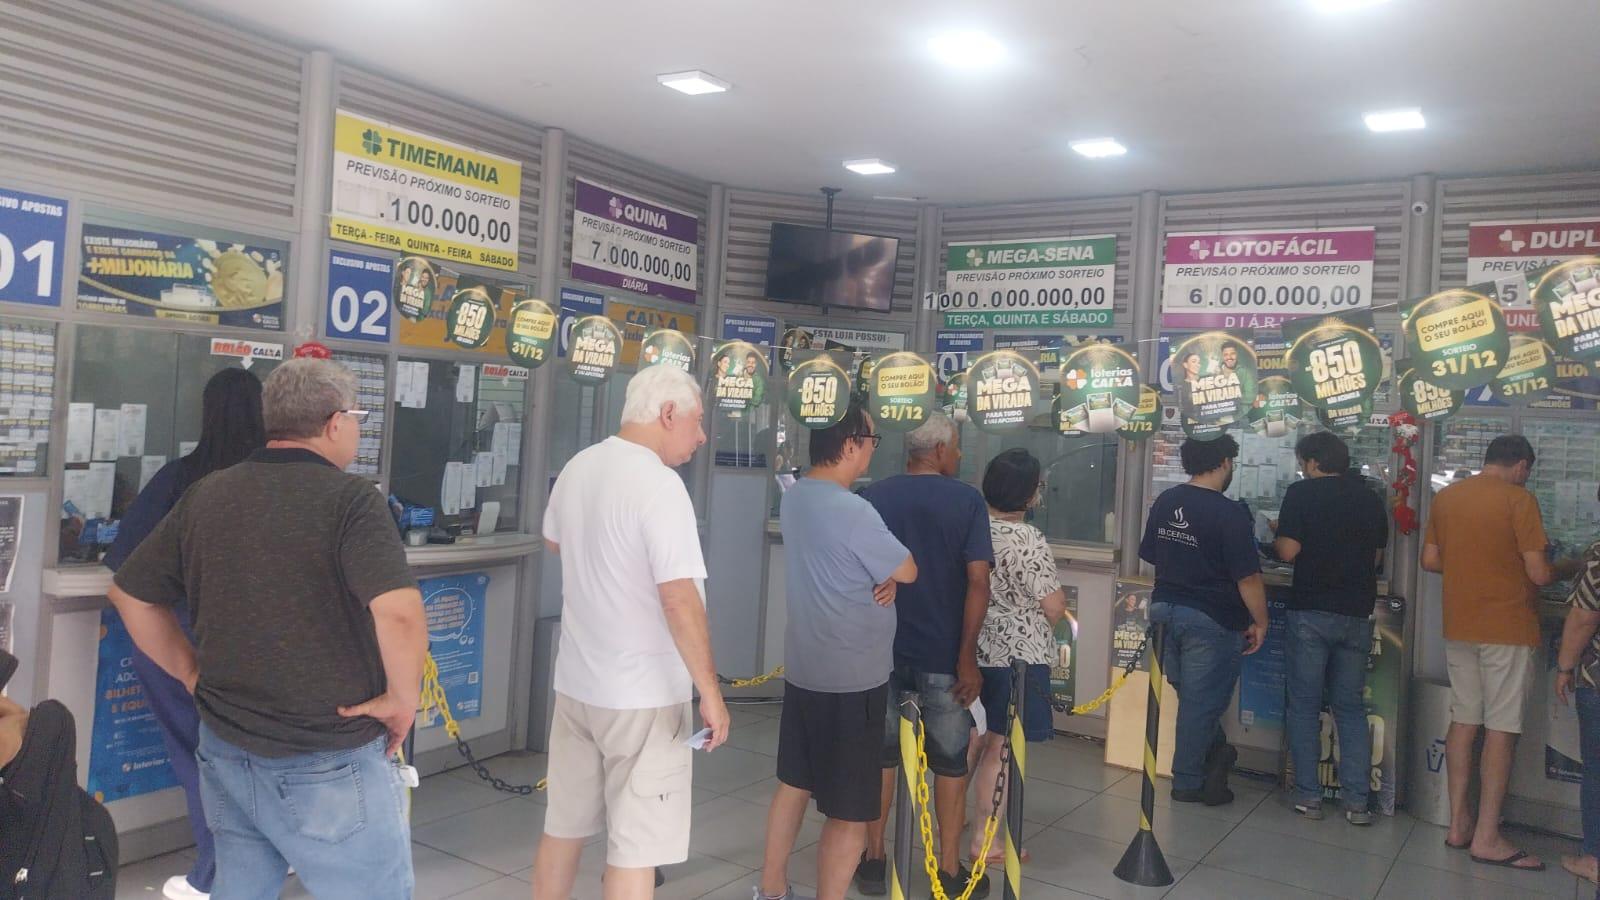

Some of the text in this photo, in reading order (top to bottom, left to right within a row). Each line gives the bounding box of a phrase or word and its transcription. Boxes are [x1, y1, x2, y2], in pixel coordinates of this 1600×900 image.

[387, 137, 499, 185] TIMEMANIA
[346, 159, 511, 210] PREVISÃO PRÓXIMO SORTEIO
[21, 200, 63, 217] APOSTAS
[624, 203, 669, 230] QUINA
[336, 223, 368, 240] TERÇA
[375, 231, 401, 247] FEIRA
[407, 237, 440, 254] QUINTA
[447, 246, 473, 260] FEIRA
[582, 216, 691, 255] PREVISÃO PRÓXIMO SORTEIO
[987, 245, 1094, 265] MEGA-SENA
[1213, 236, 1338, 257] LOTOFÁCIL
[592, 240, 691, 282] 7.000.000,00
[1176, 264, 1360, 277] PREVISÃO PRÓXIMO SORTEIO
[622, 276, 649, 293] DIÁRIA
[955, 268, 1104, 282] PREVISÃO PRÓXIMO SORTEIO
[1188, 284, 1361, 309] 6.000.000,00
[330, 285, 388, 337] 02
[457, 302, 488, 330] 850
[947, 309, 1107, 328] TERÇA, QUINTA E SÁBADO
[1421, 310, 1484, 334] COMPRE AQUI
[1425, 318, 1487, 342] O SEU BOLÃO!
[1555, 319, 1578, 338] DA
[813, 328, 833, 338] ESTA
[835, 330, 854, 340] LOJA
[253, 345, 281, 358] CAIXA
[512, 342, 544, 361] 31/12
[575, 336, 616, 354] MEGA
[1442, 343, 1477, 356] SORTEIO
[662, 349, 691, 362] loterias
[1309, 340, 1363, 383] 850
[1431, 350, 1497, 377] 31/12
[509, 369, 528, 378] CAIXA
[880, 373, 907, 382] COMPRE
[1091, 366, 1133, 378] loterias
[718, 376, 754, 388] MEGA
[801, 376, 838, 404] 850
[976, 377, 1032, 395] MEGA
[1091, 377, 1134, 388] CAIXA
[1191, 373, 1240, 392] MEGA
[1315, 373, 1366, 399] MILHÕES
[1502, 376, 1548, 396] 31/12
[976, 392, 1032, 412] DA VIRADA
[1192, 387, 1242, 405] DA VIRADA
[800, 403, 836, 417] MILHÕES
[880, 404, 923, 421] 31/12
[1114, 630, 1146, 641] MEGA
